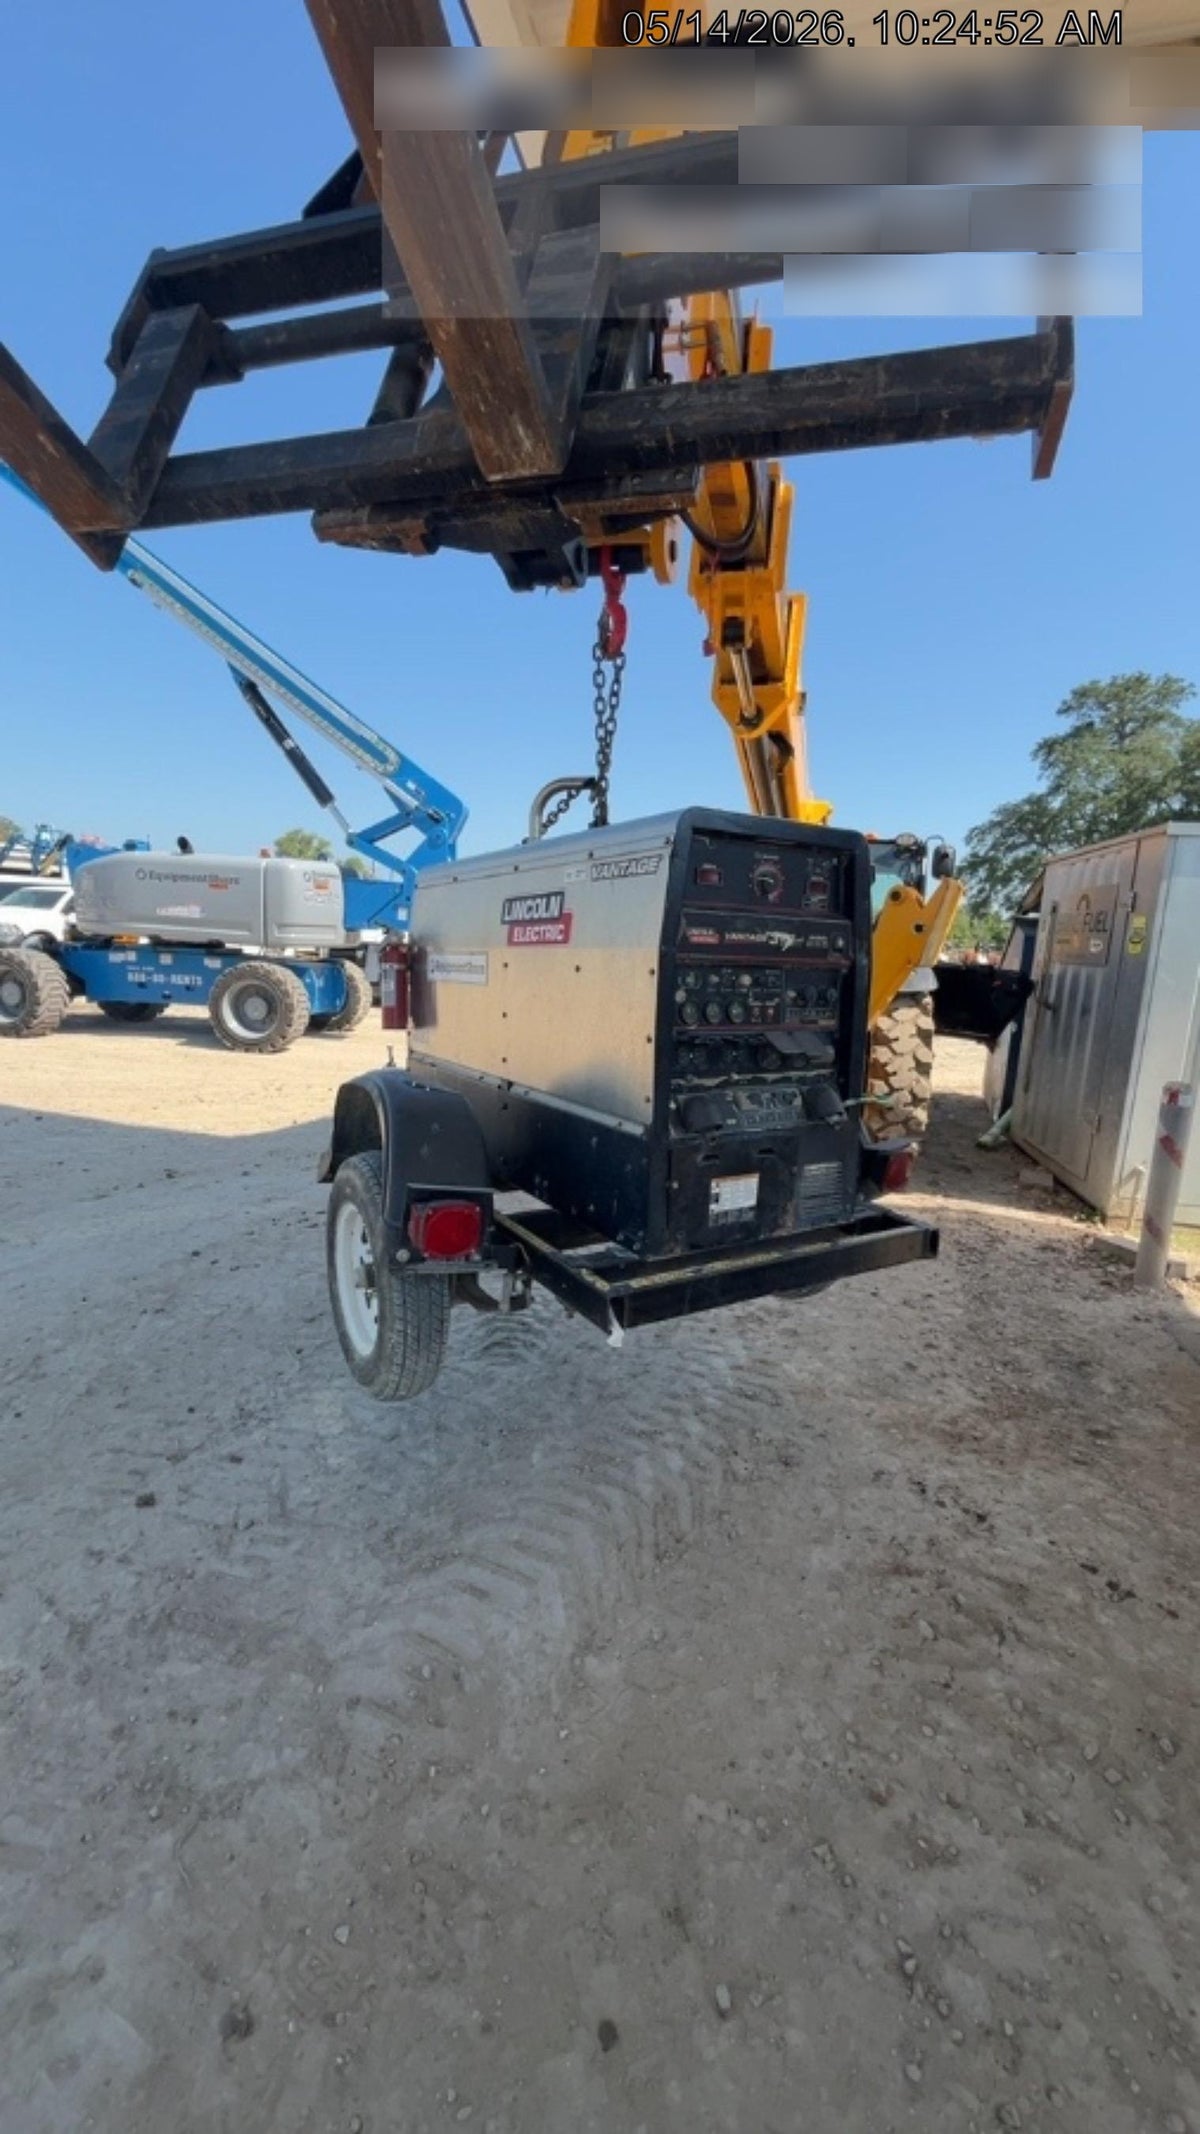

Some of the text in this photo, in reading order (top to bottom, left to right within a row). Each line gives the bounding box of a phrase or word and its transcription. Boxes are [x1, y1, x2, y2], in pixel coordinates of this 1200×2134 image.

[591, 855, 661, 881] VANTAGE
[503, 894, 563, 922] LINCOLN
[513, 923, 565, 943] ELECTRIC
